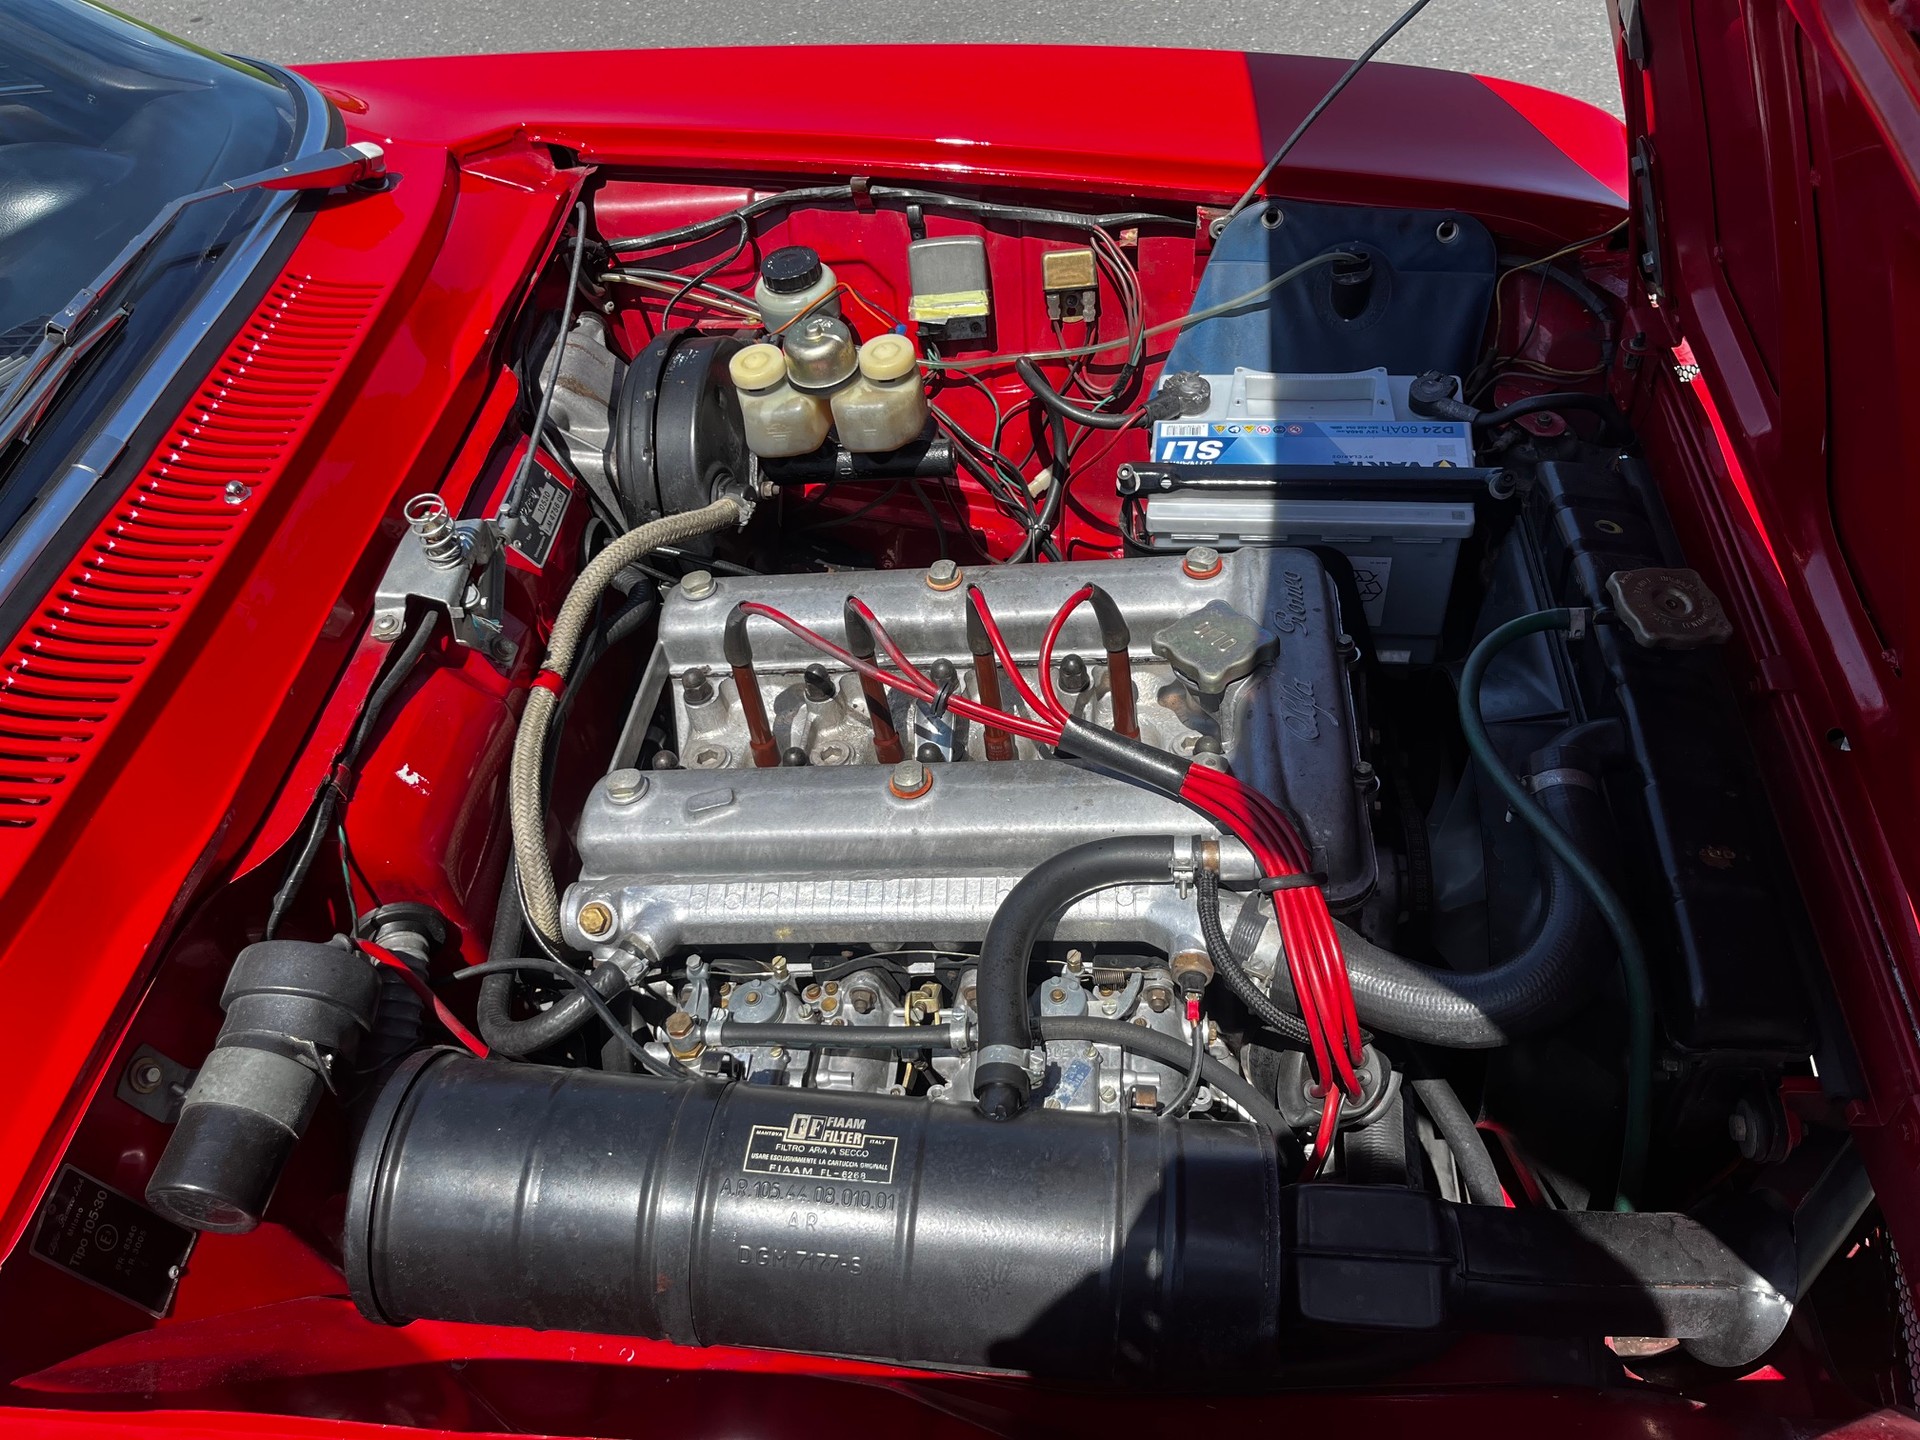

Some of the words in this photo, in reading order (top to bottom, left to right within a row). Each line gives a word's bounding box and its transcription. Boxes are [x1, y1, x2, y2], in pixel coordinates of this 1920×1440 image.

[1381, 425, 1418, 435] 60Ah
[1422, 425, 1454, 434] D24
[1162, 440, 1224, 461] SLI
[1273, 571, 1309, 637] Romeo
[826, 1116, 867, 1130] FIAAM
[823, 1130, 863, 1145] FILTER
[751, 1152, 769, 1160] USARE
[775, 1143, 805, 1153] FILTRO
[808, 1146, 828, 1155] ARIA
[839, 1148, 870, 1158] SECCO
[768, 1164, 813, 1175] FIAAM
[67, 1207, 84, 1237] Milano
[69, 1238, 88, 1266] Tipo
